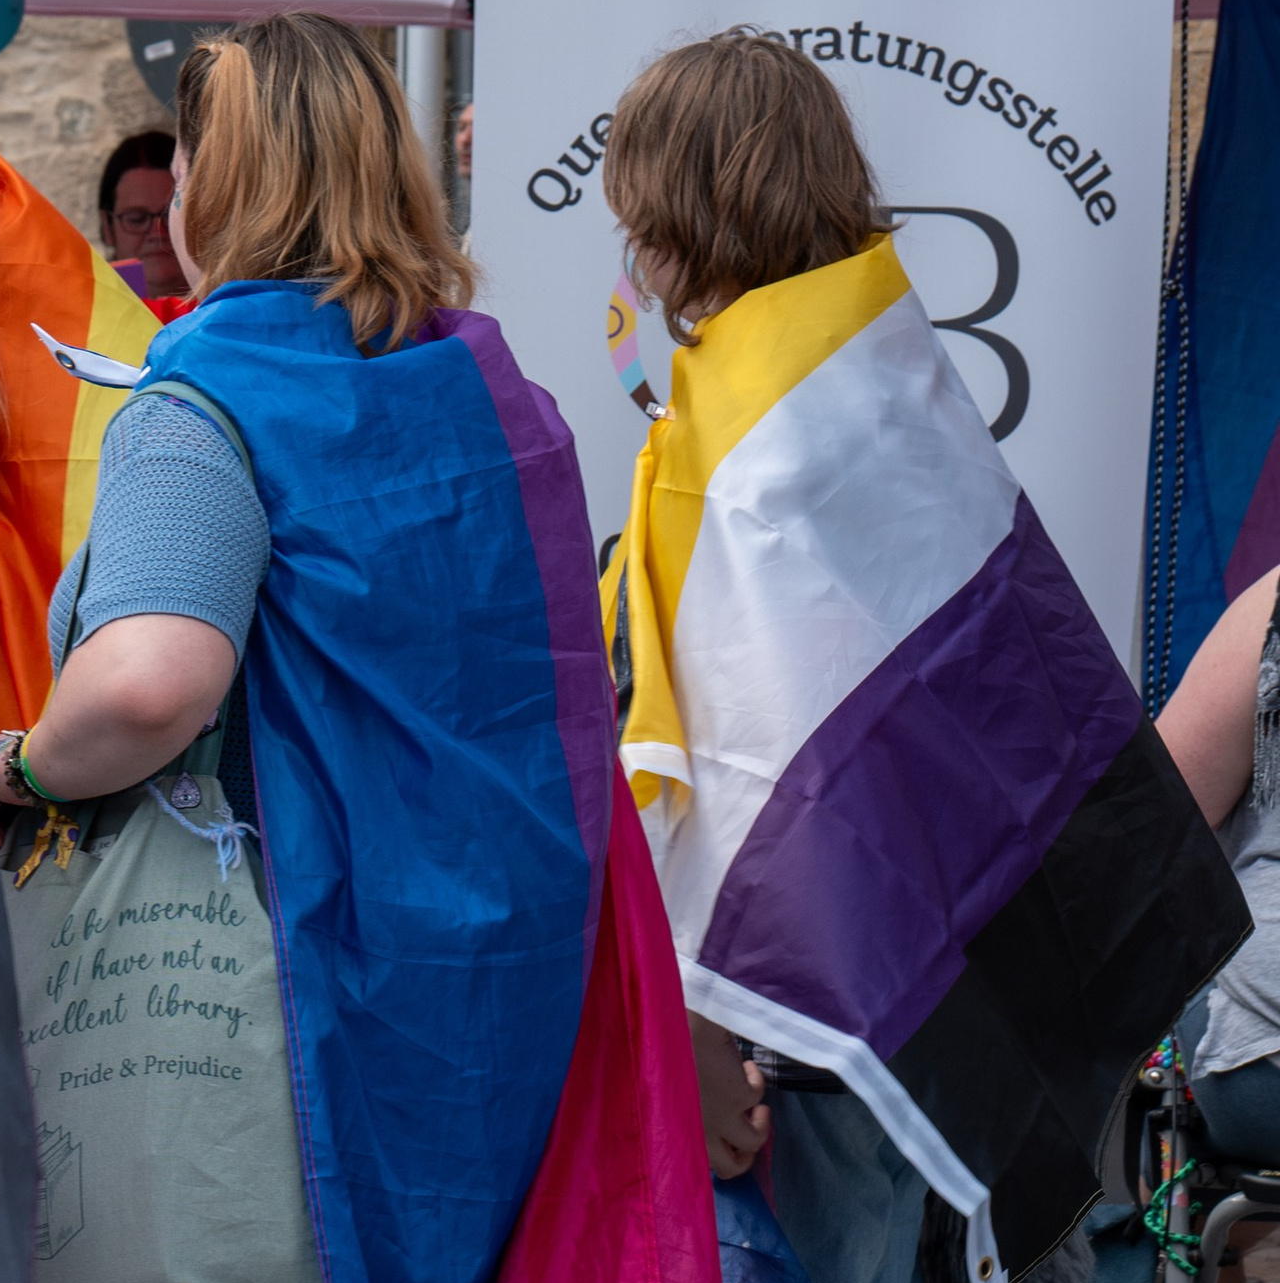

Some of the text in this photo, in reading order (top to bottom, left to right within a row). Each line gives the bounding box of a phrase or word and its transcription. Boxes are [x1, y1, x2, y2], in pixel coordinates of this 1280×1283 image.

[527, 21, 1117, 226] Que ratungsstelle
[119, 890, 247, 928] miserable
[46, 960, 70, 1004] if
[91, 947, 156, 981] have
[162, 938, 205, 970] not
[210, 952, 245, 976] an
[146, 983, 254, 1039] library.
[58, 1054, 243, 1092] Pride & Prejudice
